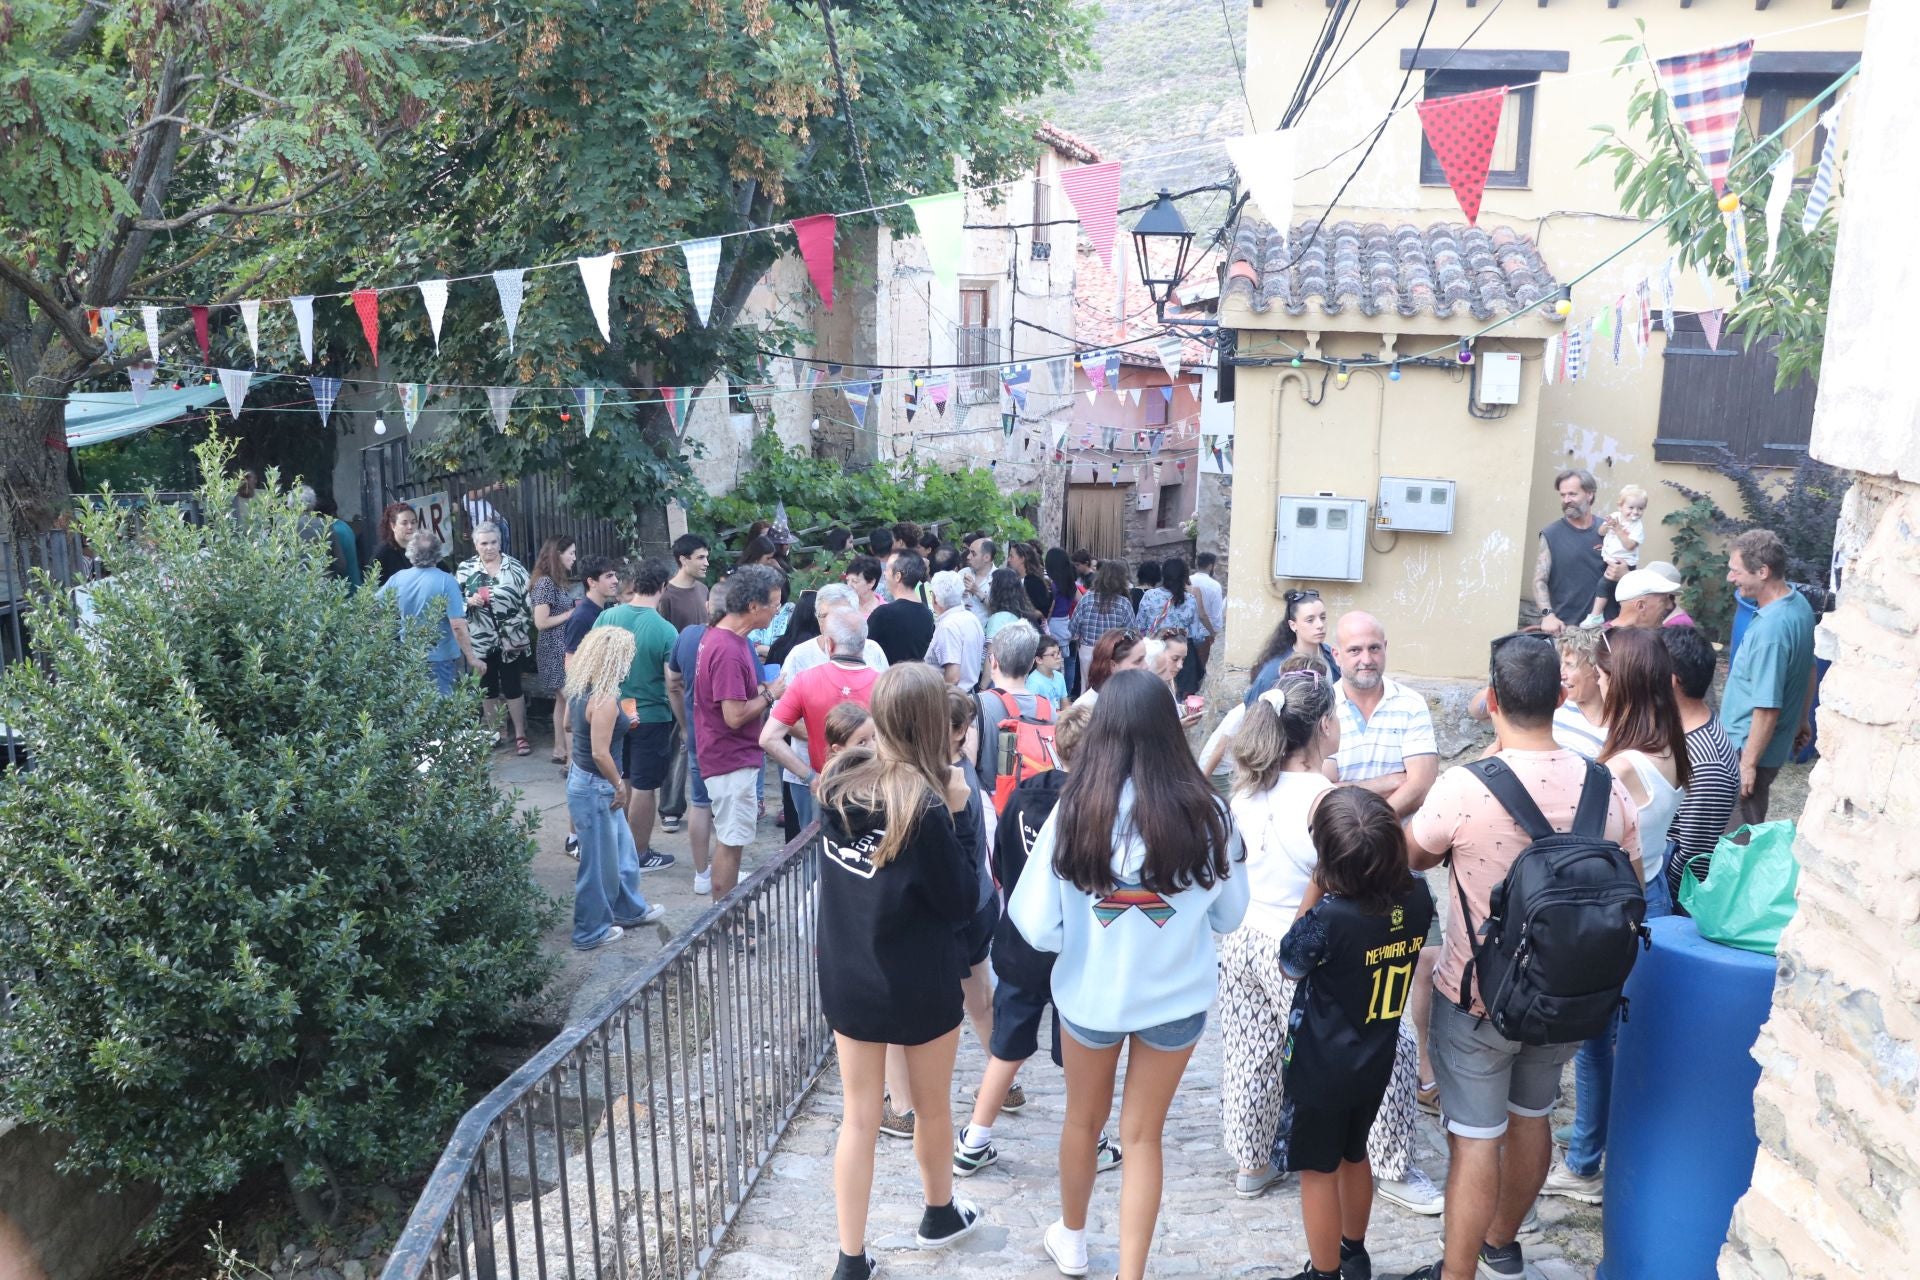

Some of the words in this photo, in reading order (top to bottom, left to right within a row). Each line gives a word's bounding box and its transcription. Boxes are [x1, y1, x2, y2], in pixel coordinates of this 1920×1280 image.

[418, 503, 445, 543] AR
[1366, 941, 1406, 966] NEYMAR
[1409, 936, 1423, 953] JR
[1365, 961, 1412, 1025] 10
